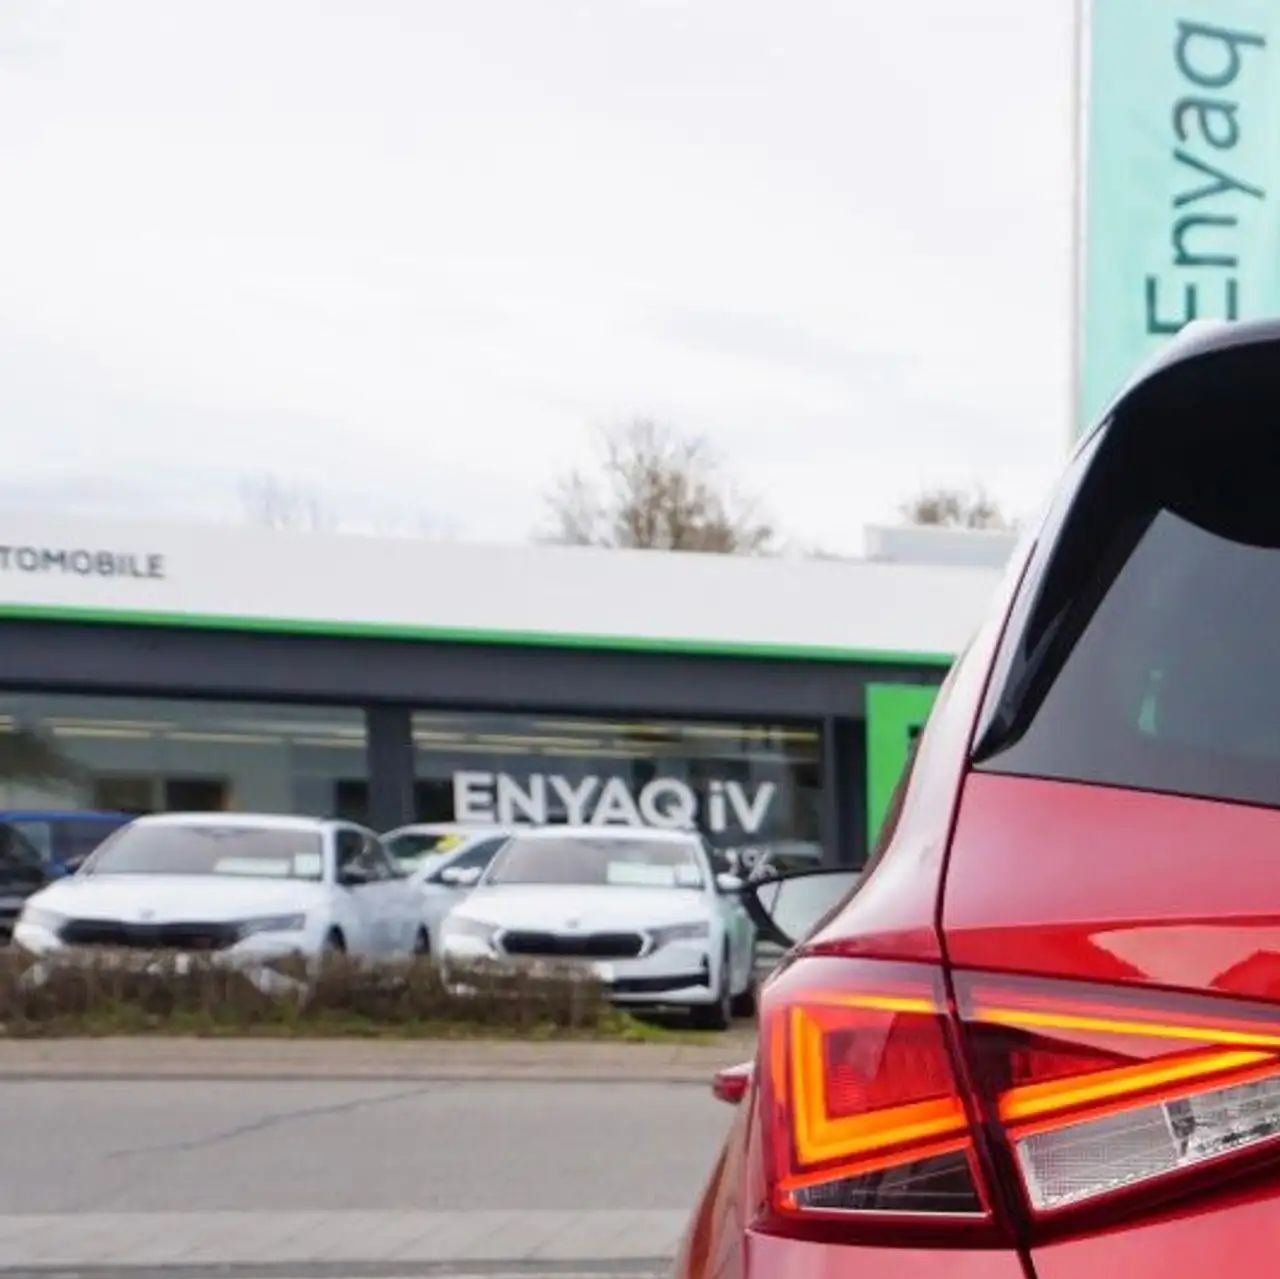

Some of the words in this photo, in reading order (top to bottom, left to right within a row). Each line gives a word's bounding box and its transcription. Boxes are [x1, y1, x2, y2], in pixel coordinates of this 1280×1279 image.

[1146, 19, 1267, 334] Enyaq
[452, 770, 697, 829] ENYAQ
[708, 780, 775, 834] iV
